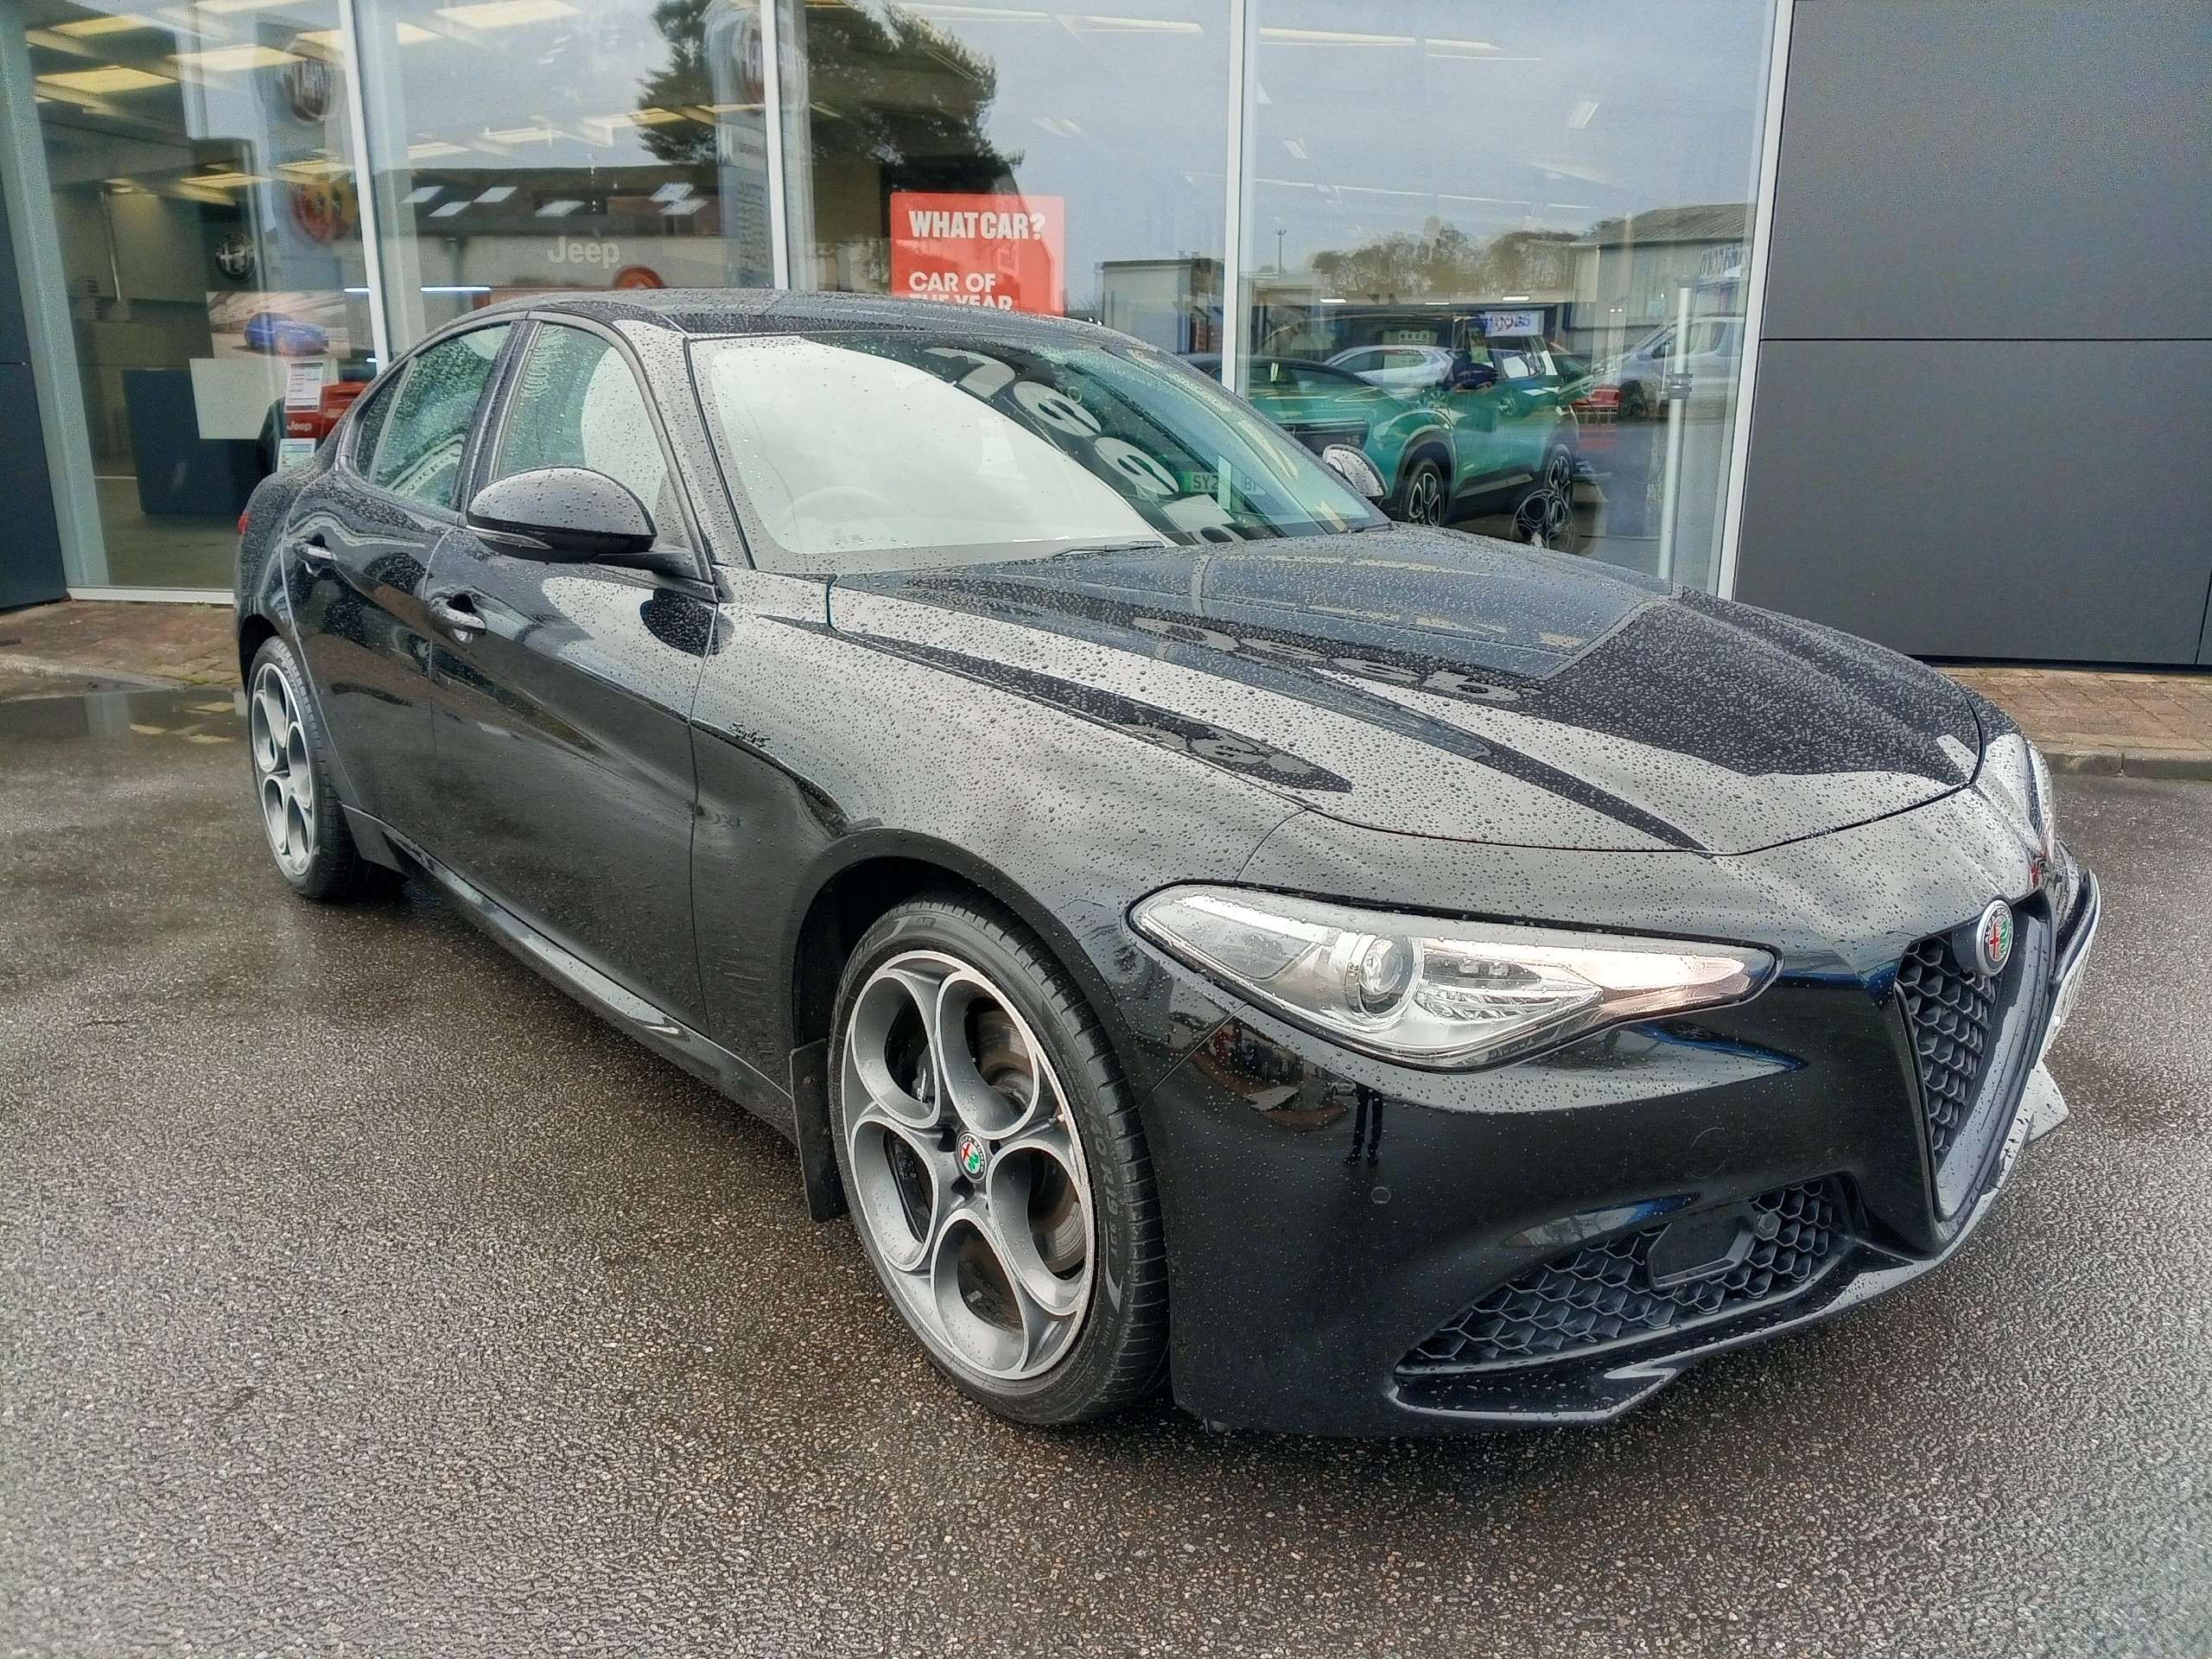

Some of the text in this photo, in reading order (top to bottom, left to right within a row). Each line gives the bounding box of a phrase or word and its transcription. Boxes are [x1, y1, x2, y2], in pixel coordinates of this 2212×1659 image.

[547, 236, 621, 270] Jeep
[908, 270, 996, 293] CAR OF
[286, 420, 313, 432] Jeep
[1985, 915, 1996, 944] ALFA
